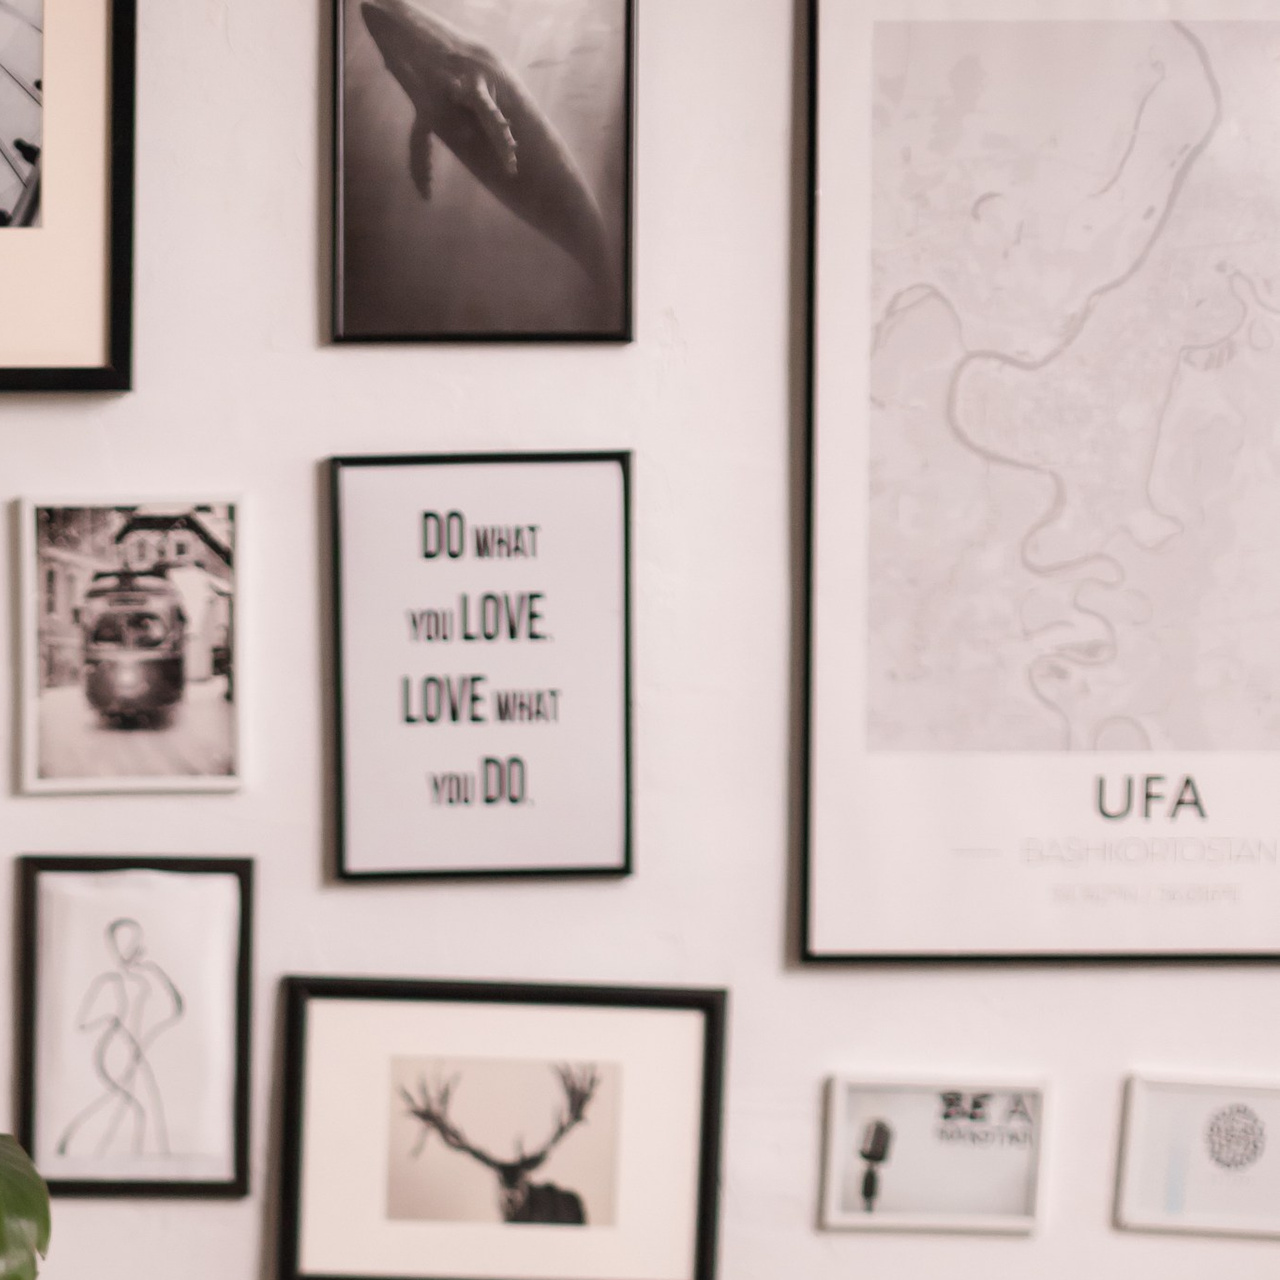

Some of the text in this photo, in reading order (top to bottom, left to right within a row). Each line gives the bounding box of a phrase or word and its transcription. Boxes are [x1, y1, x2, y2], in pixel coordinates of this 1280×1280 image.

[422, 510, 540, 560] DO WHAT
[409, 609, 455, 641] YOU
[403, 676, 561, 724] LOVE WHAT
[431, 772, 475, 806] YOU
[1095, 773, 1208, 820] UFA
